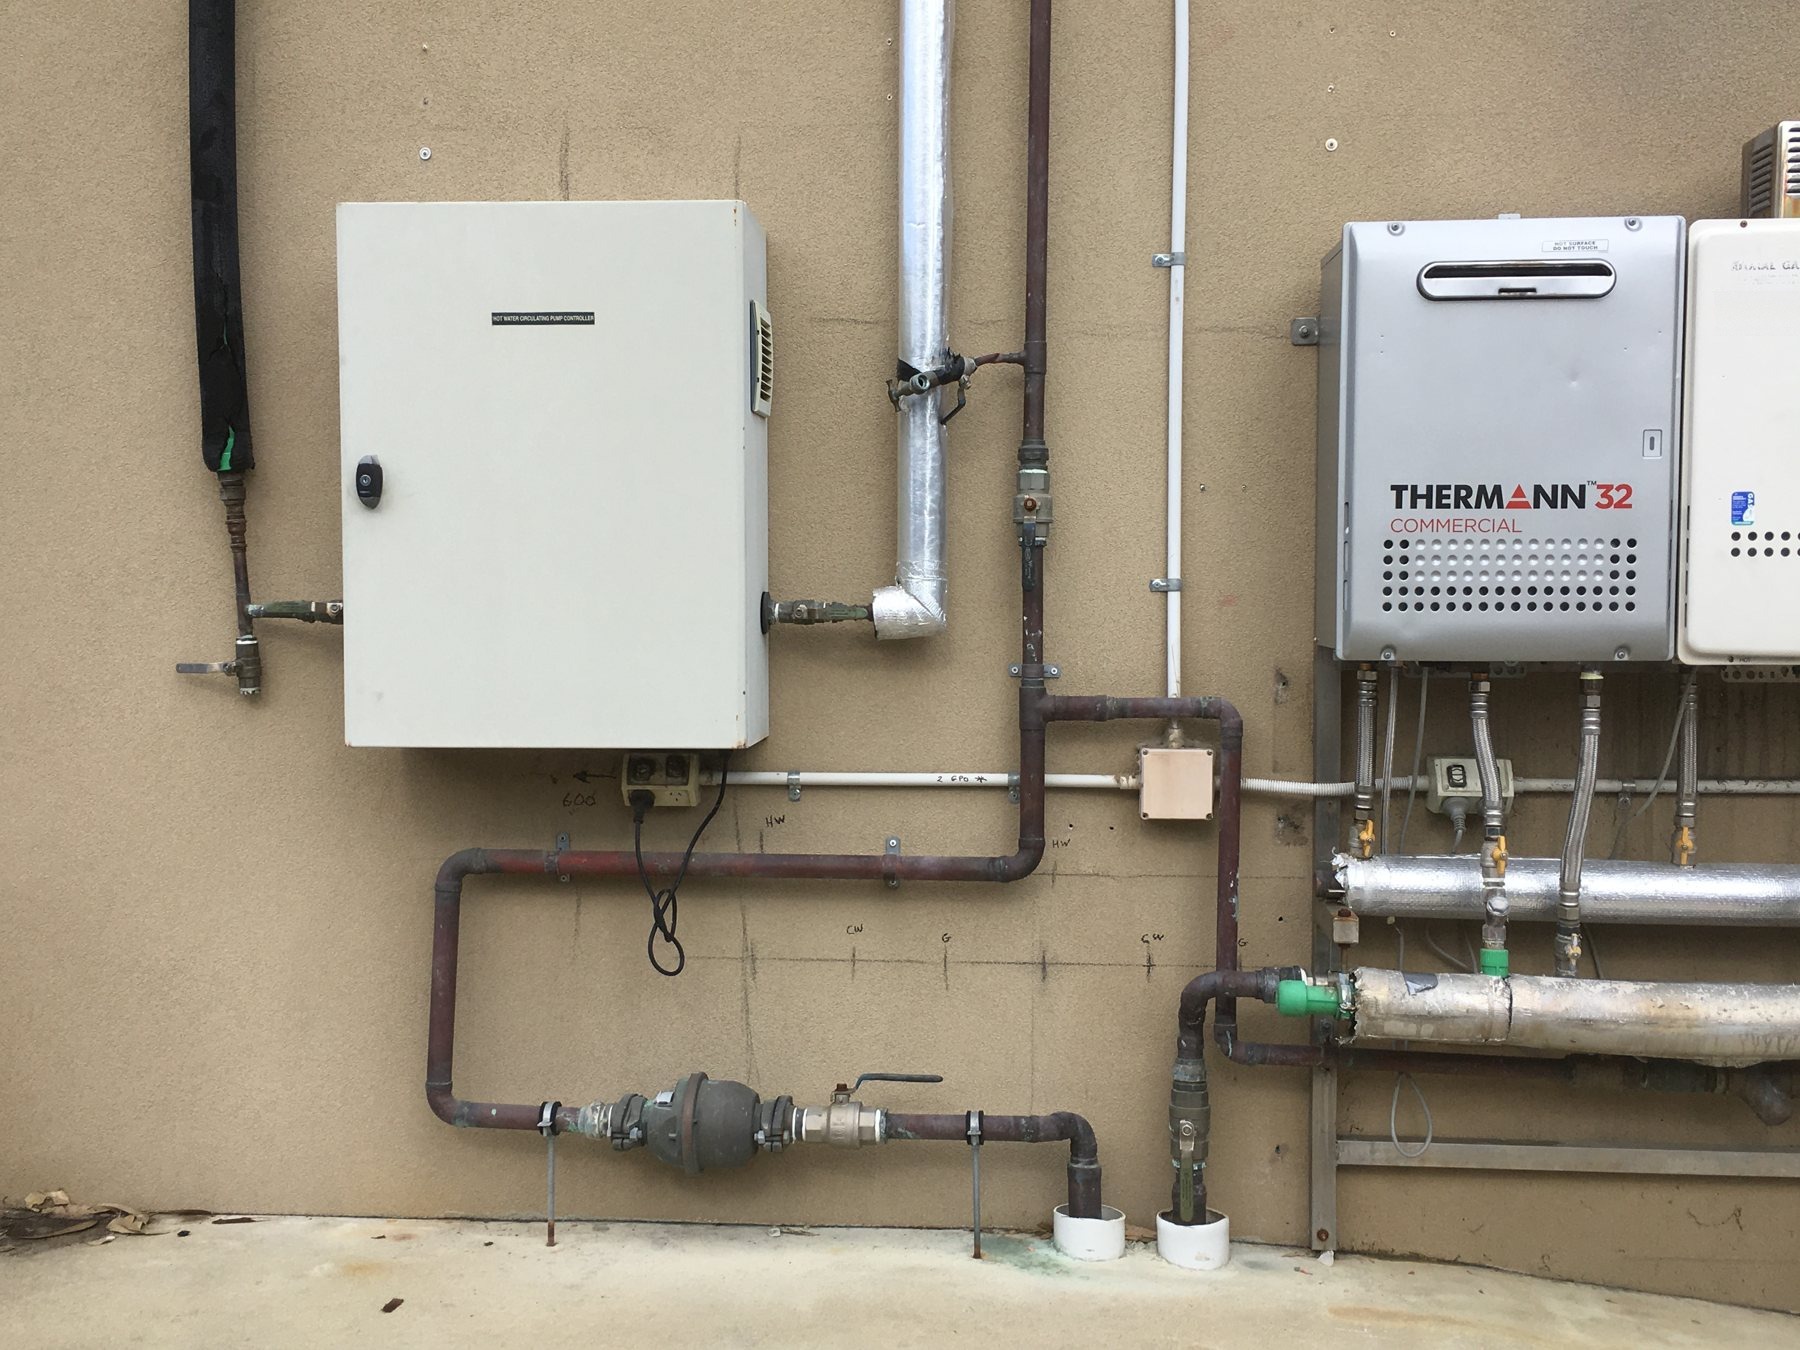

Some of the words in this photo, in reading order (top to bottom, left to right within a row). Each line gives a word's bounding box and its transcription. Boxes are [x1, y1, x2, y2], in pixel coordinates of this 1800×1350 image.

[1594, 483, 1633, 510] 32
[1390, 518, 1522, 533] COMMERCIAL
[937, 775, 943, 783] 2
[563, 792, 596, 807] 600
[765, 814, 785, 828] HW
[1052, 838, 1071, 848] HW
[846, 923, 863, 935] CW
[942, 932, 952, 943] G
[1237, 938, 1248, 947] G
